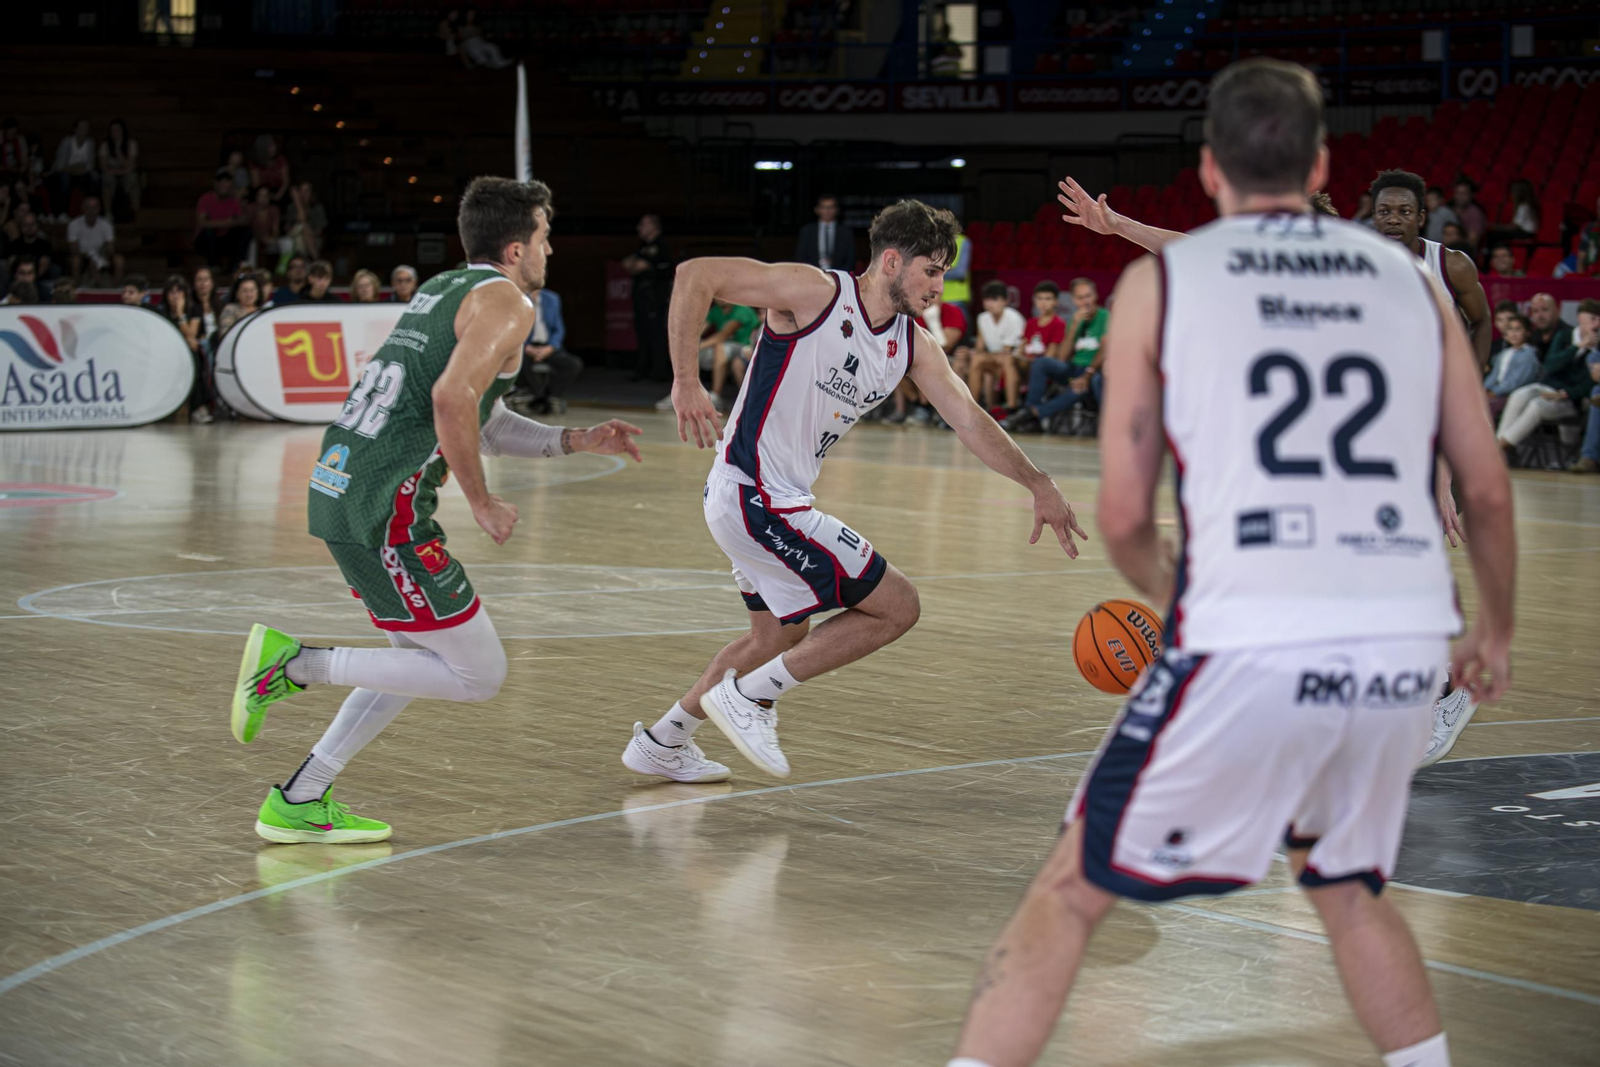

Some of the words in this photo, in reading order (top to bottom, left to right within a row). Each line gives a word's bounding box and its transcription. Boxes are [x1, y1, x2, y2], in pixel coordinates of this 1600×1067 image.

[901, 85, 1000, 108] SEVILLA
[1227, 248, 1377, 277] JUANMA
[2, 357, 125, 406] Asada
[824, 367, 858, 399] Jaén
[2, 405, 131, 423] INTERNACIONAL
[333, 359, 406, 439] 32
[1247, 351, 1397, 478] 22
[837, 527, 861, 551] 10
[1127, 609, 1160, 660] Wilso
